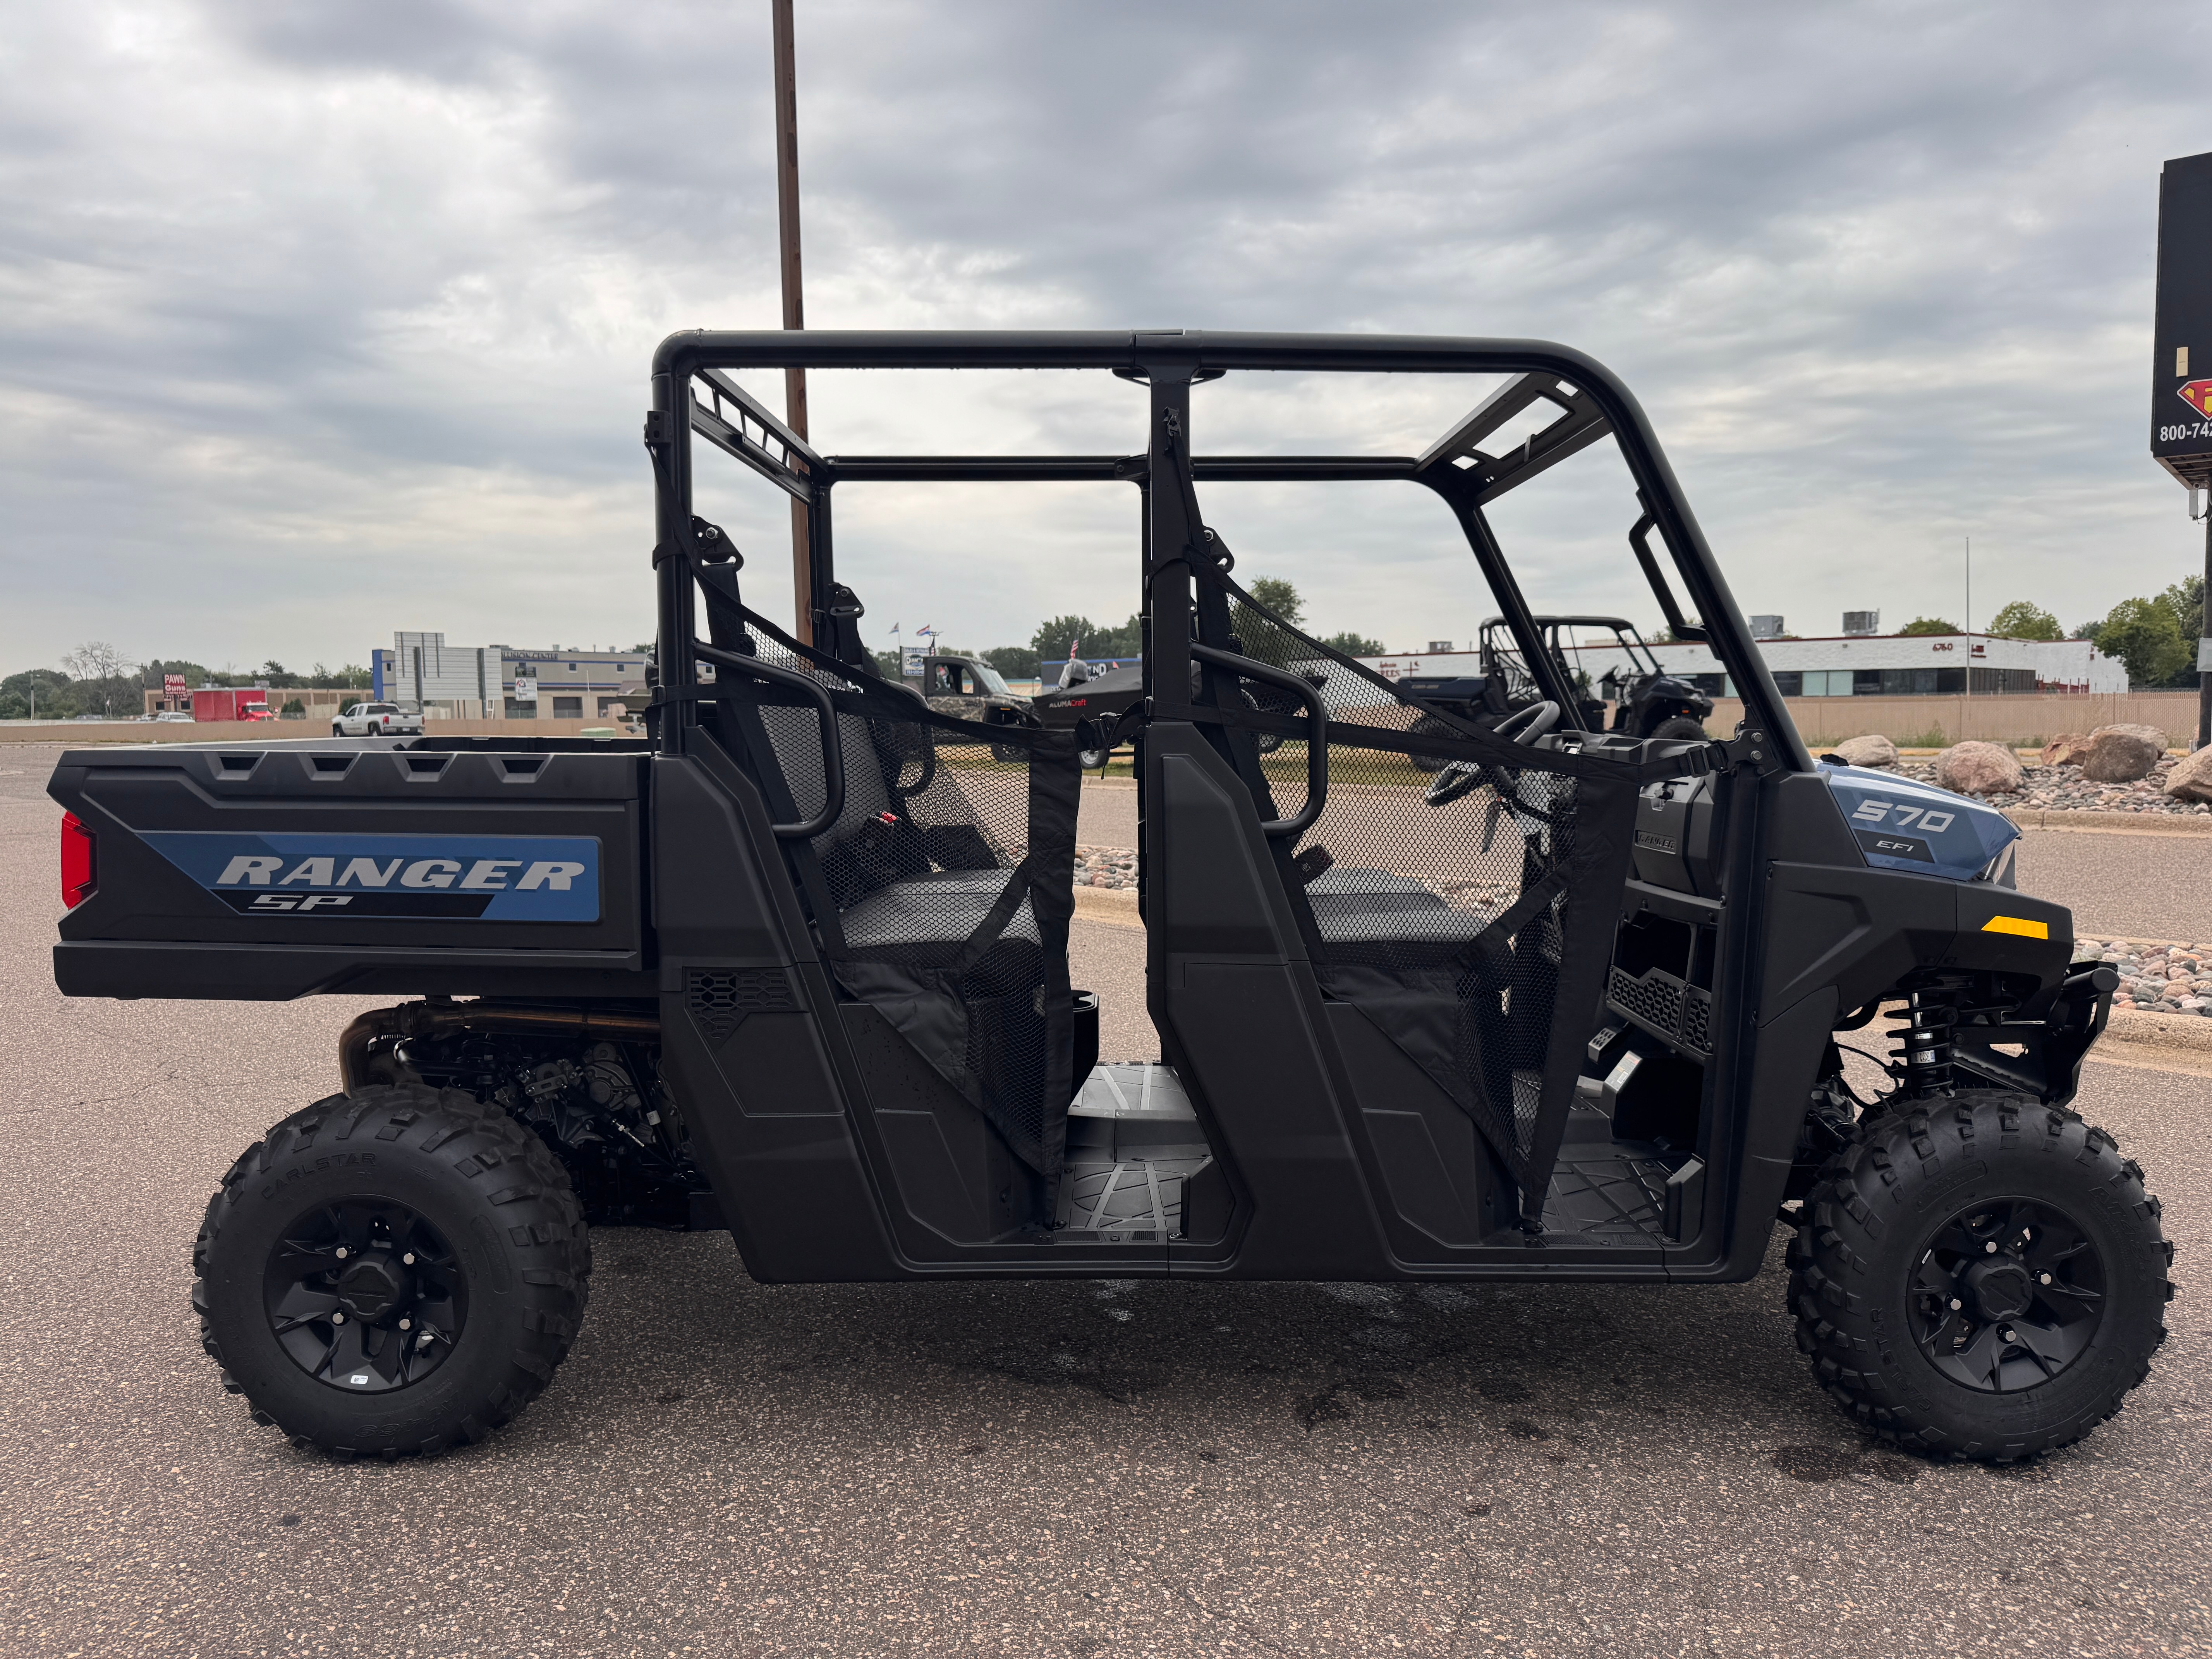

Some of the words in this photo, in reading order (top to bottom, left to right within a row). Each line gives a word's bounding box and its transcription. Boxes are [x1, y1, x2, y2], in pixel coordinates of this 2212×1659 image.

[164, 674, 185, 684] PAWN
[1851, 799, 1955, 833] 570
[1876, 840, 1914, 852] EFI
[216, 855, 585, 890] RANGER
[247, 895, 354, 910] SP
[261, 1152, 377, 1201] CARLSTAR
